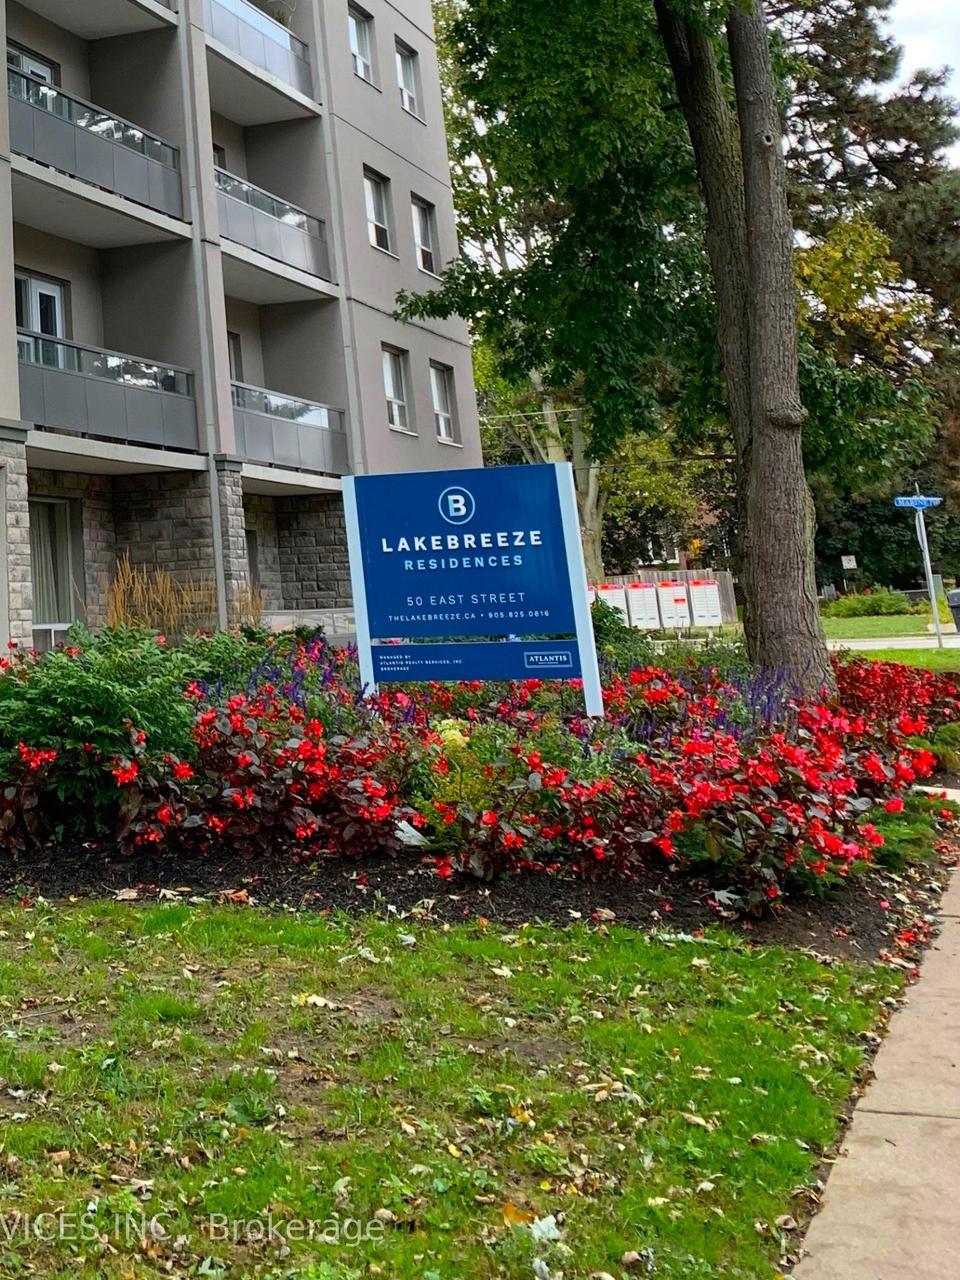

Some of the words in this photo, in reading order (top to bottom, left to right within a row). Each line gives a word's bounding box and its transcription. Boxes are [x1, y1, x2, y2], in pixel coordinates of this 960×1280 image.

[447, 495, 467, 516] B
[382, 531, 542, 552] LAKEBREEZE
[404, 555, 523, 570] RESIDENCES
[407, 596, 423, 606] 50
[430, 595, 464, 605] EAST
[471, 592, 525, 604] STREET
[388, 613, 476, 622] THELAKEBREEZE.CA
